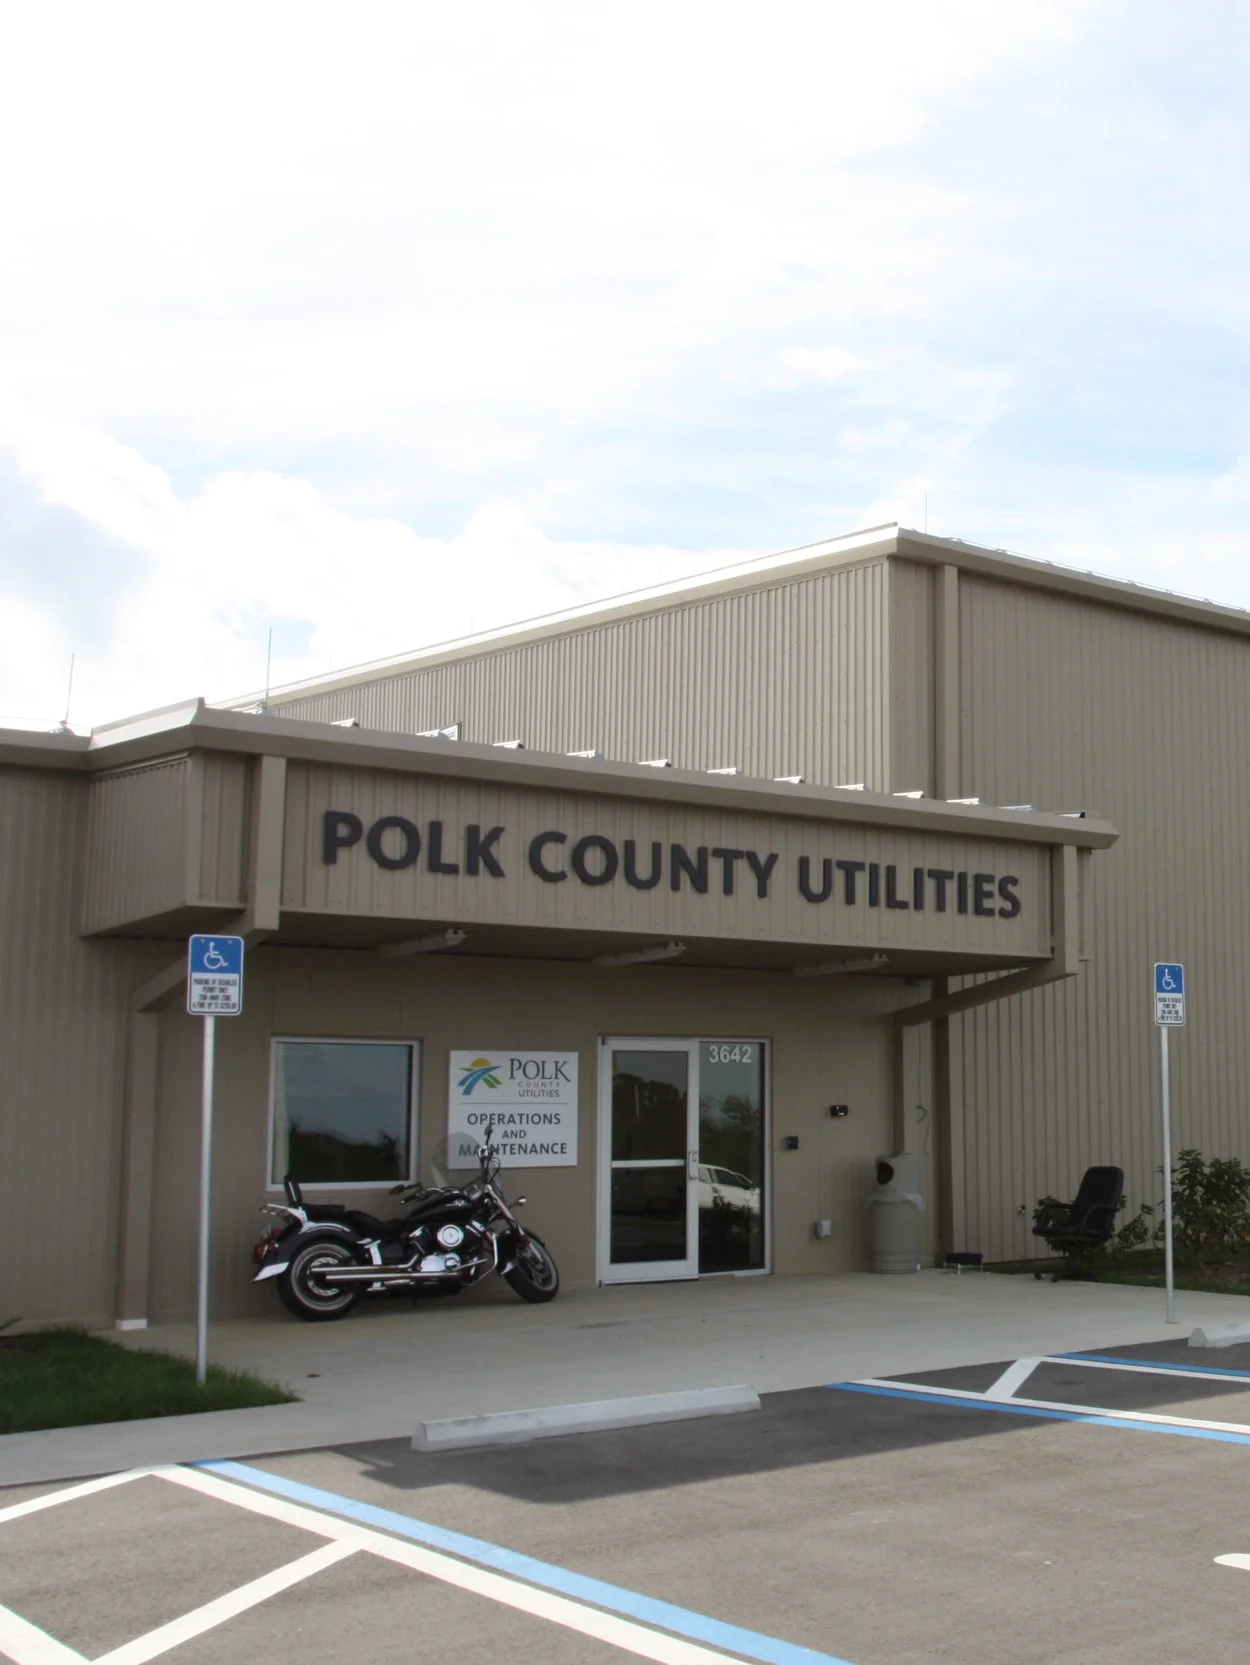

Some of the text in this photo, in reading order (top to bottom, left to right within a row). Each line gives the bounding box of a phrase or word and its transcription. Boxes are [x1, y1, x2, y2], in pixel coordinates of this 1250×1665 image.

[322, 809, 1022, 919] POLK COUNTY UTILITIES
[708, 1045, 752, 1064] 3642
[508, 1058, 571, 1083] POLK
[518, 1089, 560, 1098] UTILITIES
[467, 1113, 561, 1126] OPERATIONS
[502, 1130, 527, 1139] AND
[458, 1142, 568, 1157] MANTENANCE
